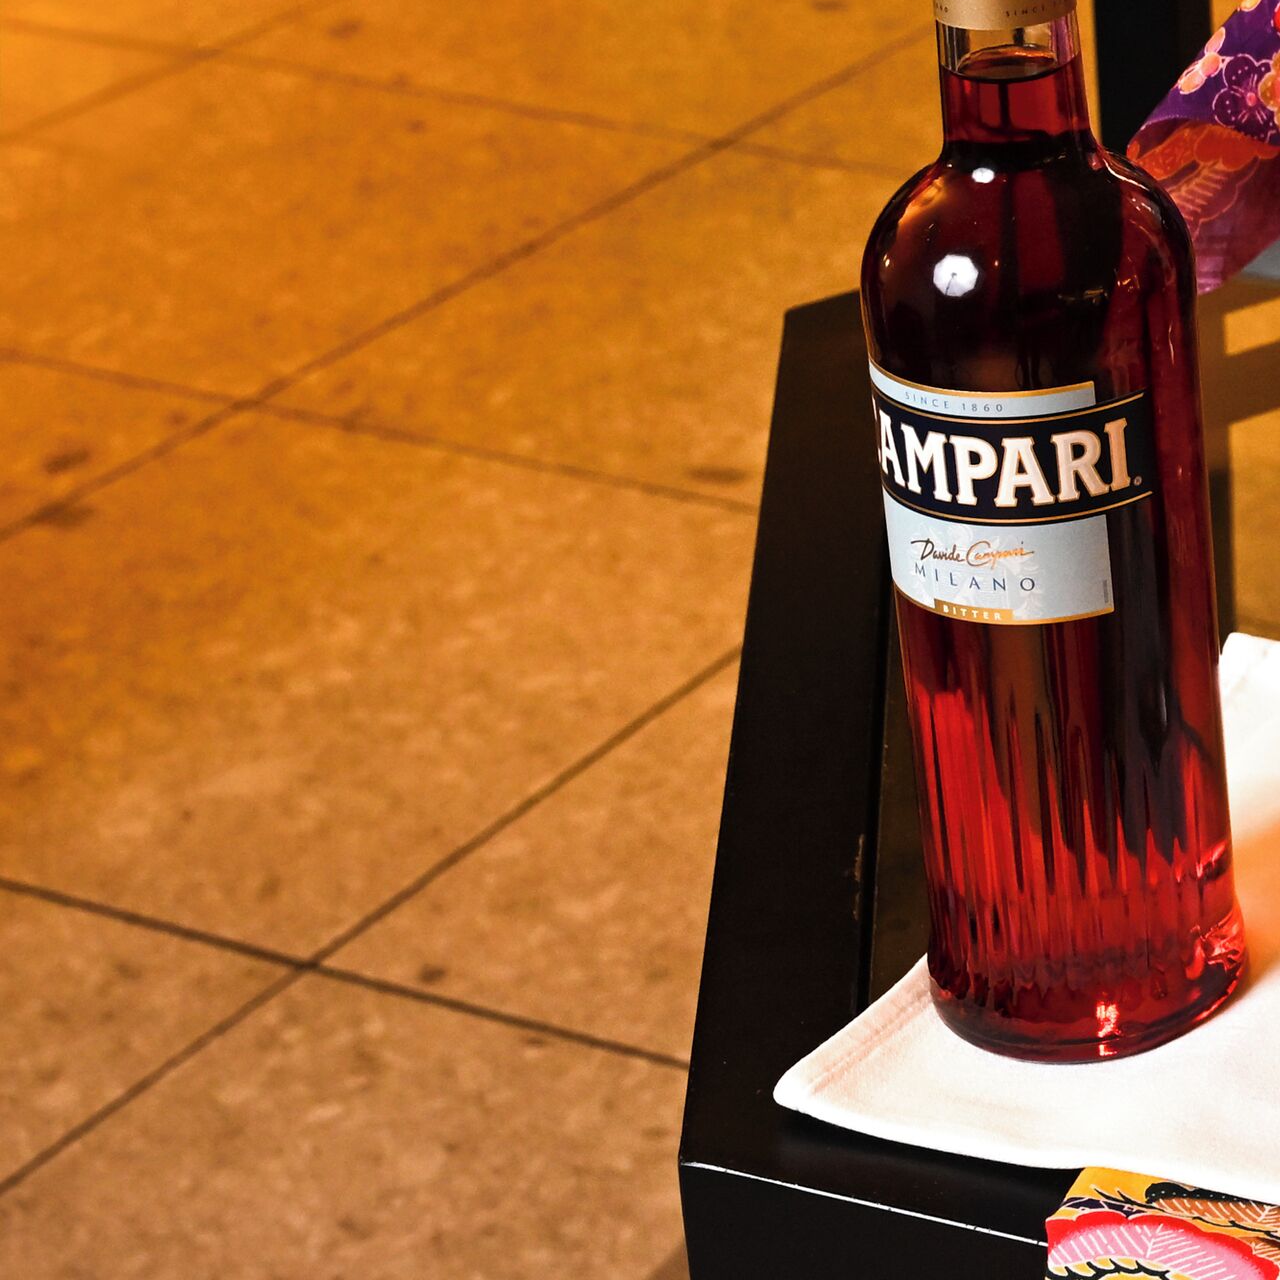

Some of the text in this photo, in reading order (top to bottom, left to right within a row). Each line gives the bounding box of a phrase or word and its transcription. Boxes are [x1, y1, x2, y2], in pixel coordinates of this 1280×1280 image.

[904, 391, 1003, 413] SINCE 1860
[871, 408, 1132, 508] AMPARI
[914, 562, 1036, 592] MILANO
[942, 604, 1003, 620] BITTER
